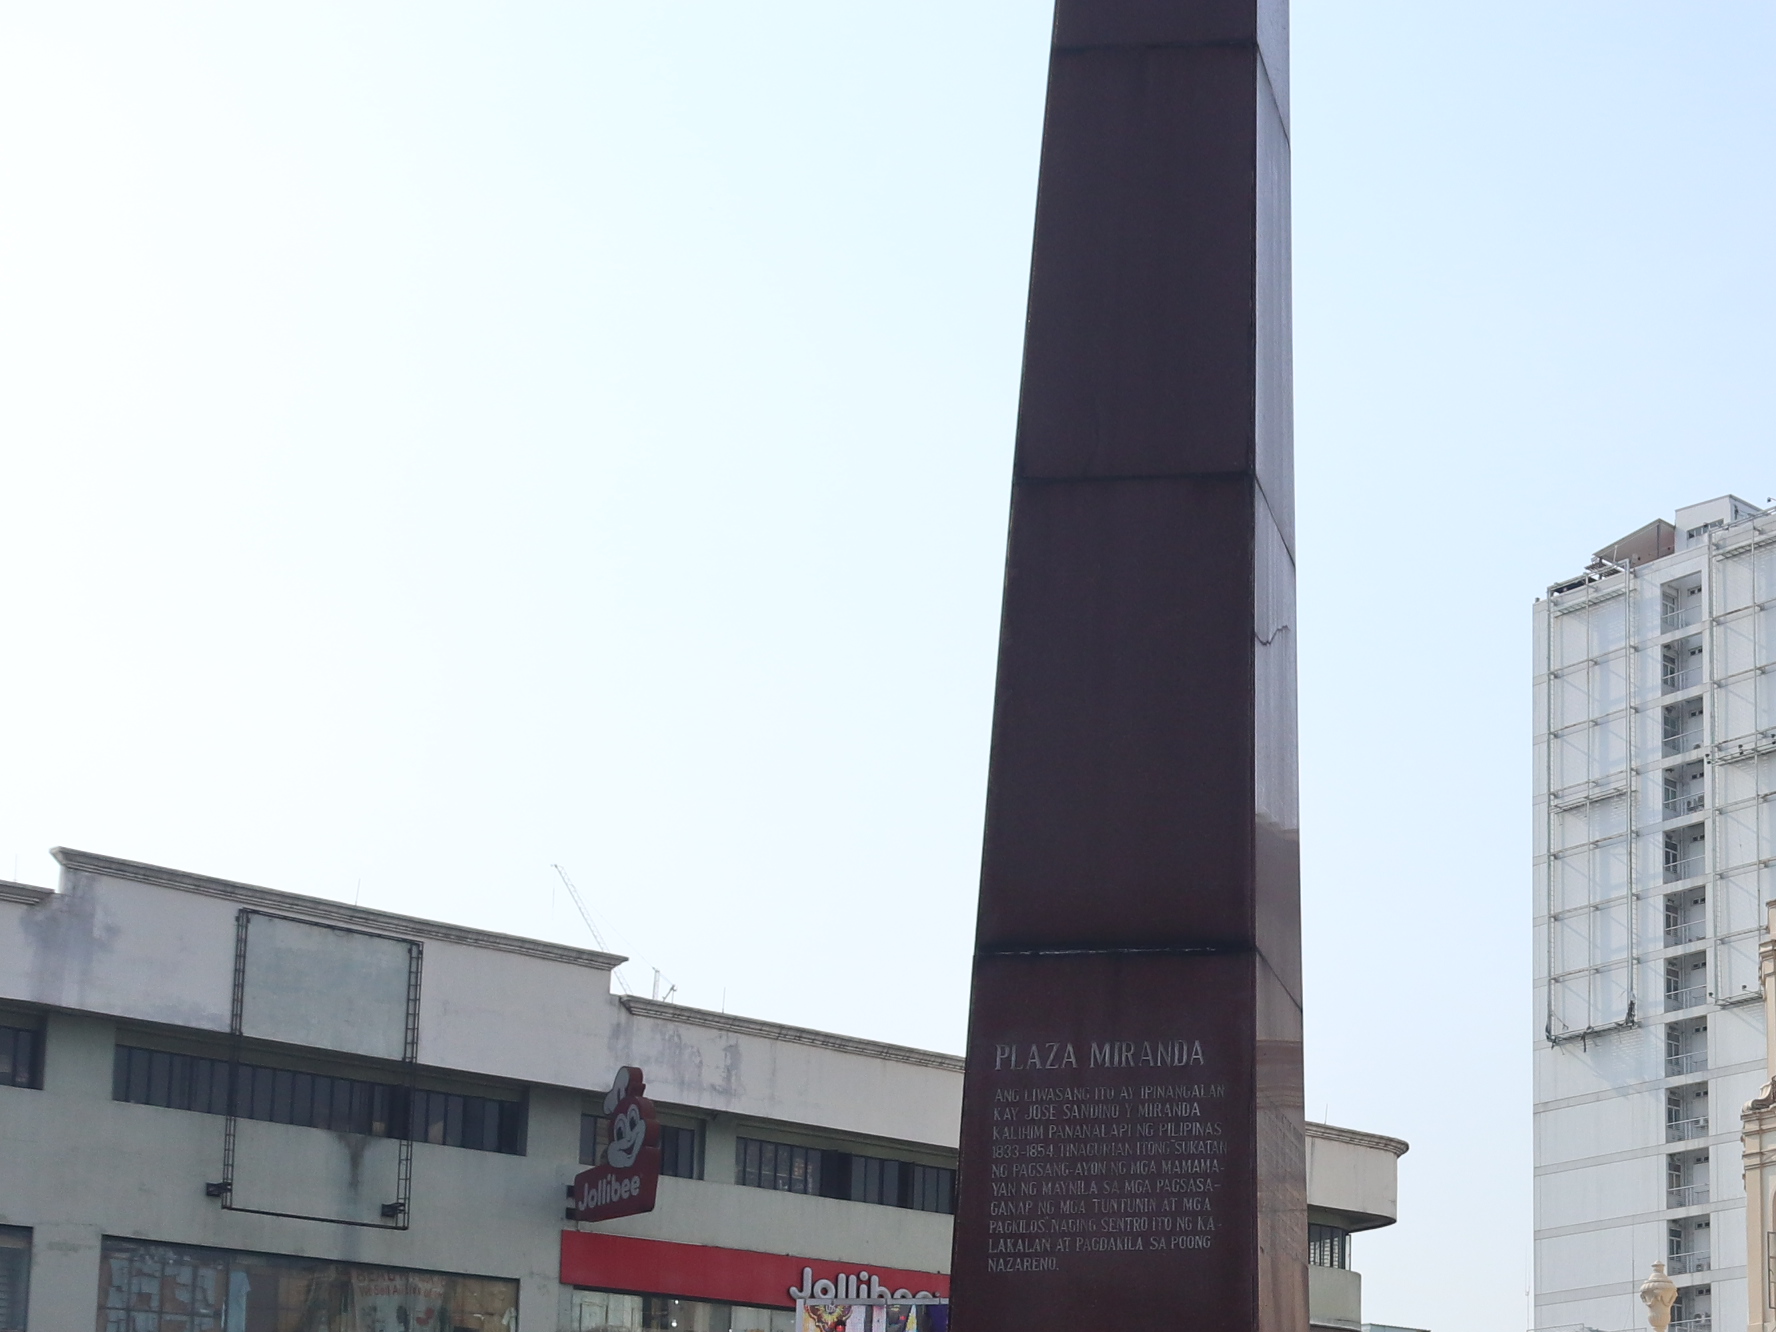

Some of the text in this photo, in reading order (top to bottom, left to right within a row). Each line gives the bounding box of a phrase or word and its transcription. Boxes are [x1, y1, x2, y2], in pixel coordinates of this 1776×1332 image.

[994, 1039, 1205, 1071] PLAZA MIRANDA
[995, 1084, 1225, 1102] ANG LIWASANG ITO AY IPINANGALAN
[993, 1102, 1201, 1121] KAY JOSE SANDINO Y MIRANDA
[993, 1122, 1222, 1140] KALIHIM PANANALAPI NG PILIPINAS
[992, 1159, 1225, 1178] NG PAGSANG-AYON NG MGA MAMAMA-
[578, 1173, 640, 1211] Jollibee
[992, 1178, 1221, 1196] YAN NG MAYNILA SA MGA PAGSASA-
[990, 1197, 1211, 1216] GANAP NG MGA TUNTUNIN AT MGA
[1051, 1218, 1096, 1233] NAGING
[1101, 1217, 1148, 1232] SENTRO
[1152, 1216, 1172, 1231] ITO
[1176, 1216, 1192, 1230] NG
[988, 1235, 1211, 1253] LAKALAN AT PAGDAKILA SA POONG
[988, 1257, 1059, 1272] NAZARENO.
